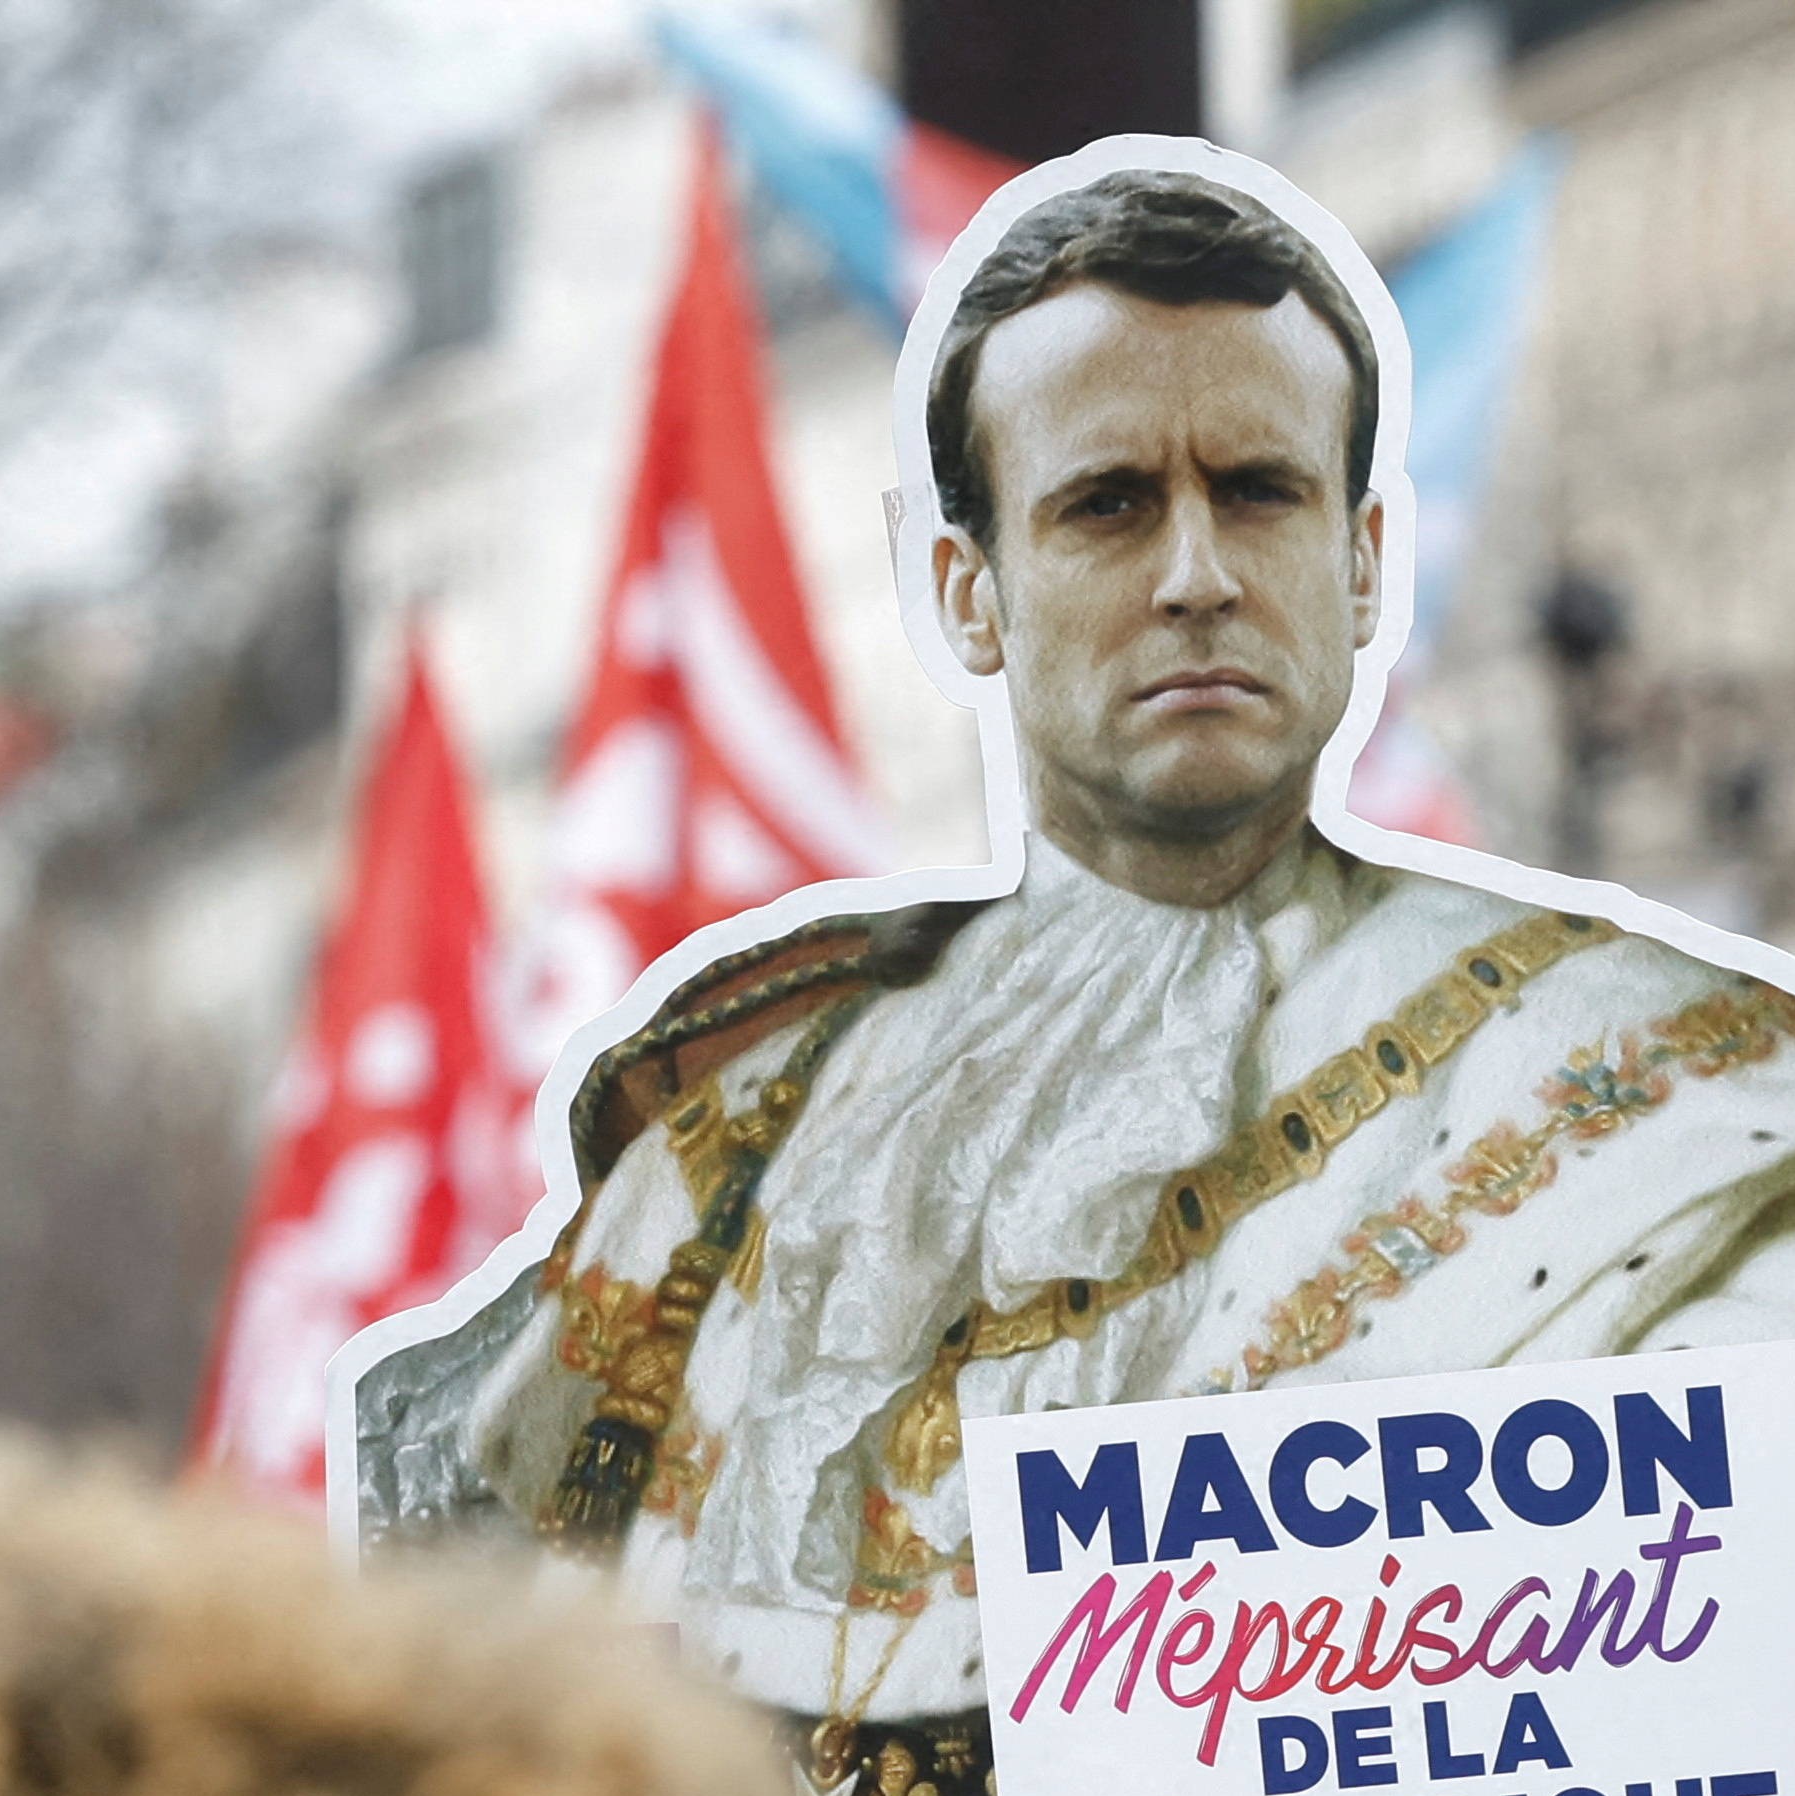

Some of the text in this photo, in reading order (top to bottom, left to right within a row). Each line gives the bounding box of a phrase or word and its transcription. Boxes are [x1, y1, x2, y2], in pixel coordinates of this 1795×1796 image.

[1015, 1384, 1734, 1574] MACRON
[1009, 1500, 1722, 1766] Méprisant
[1257, 1691, 1573, 1796] DE LA
